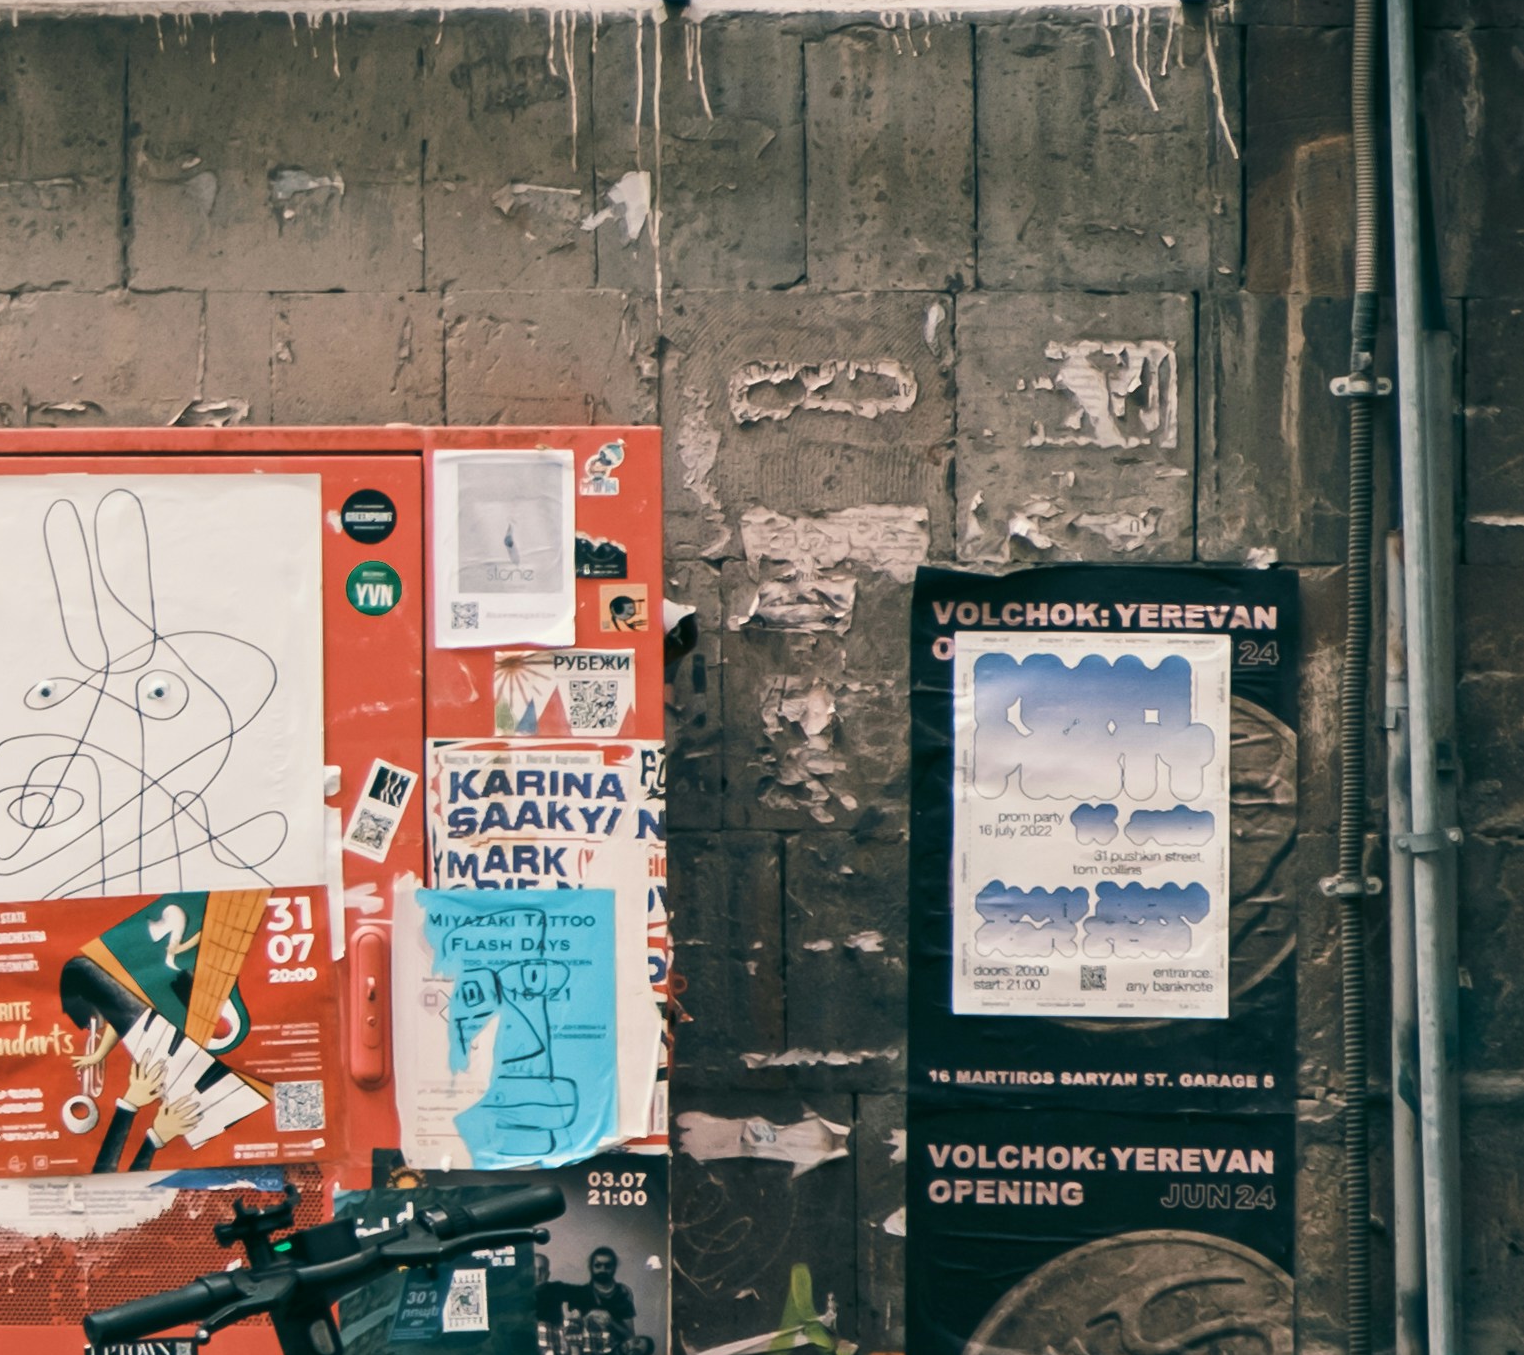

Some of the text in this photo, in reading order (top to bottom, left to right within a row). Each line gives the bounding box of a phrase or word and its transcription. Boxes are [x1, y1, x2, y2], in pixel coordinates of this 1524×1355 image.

[486, 565, 533, 582] stone
[356, 583, 394, 607] YVN
[932, 601, 1277, 629] VOLCHOK: YEREVAN
[1238, 641, 1279, 665] 24
[554, 656, 630, 670] РУБЕЖИ
[448, 770, 626, 803] KARINA
[998, 812, 1064, 825] prom party
[979, 825, 1052, 838] 16 july 2022
[448, 845, 569, 878] MARK
[1094, 851, 1108, 861] 31
[1111, 851, 1161, 864] pushkin
[1073, 865, 1142, 875] tom collins
[267, 896, 312, 931] 31
[430, 913, 596, 926] MIYAZAKI TATTOO
[267, 934, 314, 963] 07
[452, 938, 571, 951] FLASH DAYS
[268, 967, 317, 983] 20:00
[974, 966, 1049, 976] doors: 20:00
[974, 979, 1040, 990] start: 21:00
[1126, 981, 1213, 993] any banknote
[929, 1070, 1274, 1088] 16 MARTIROS SARYAN ST. GARAGE 5
[928, 1144, 1274, 1174] VOLCHOK: YEREVAN
[586, 1171, 647, 1189] 03.07
[586, 1190, 648, 1206] 21:00
[928, 1180, 1085, 1206] OPENING
[1160, 1184, 1275, 1210] JUN 24
